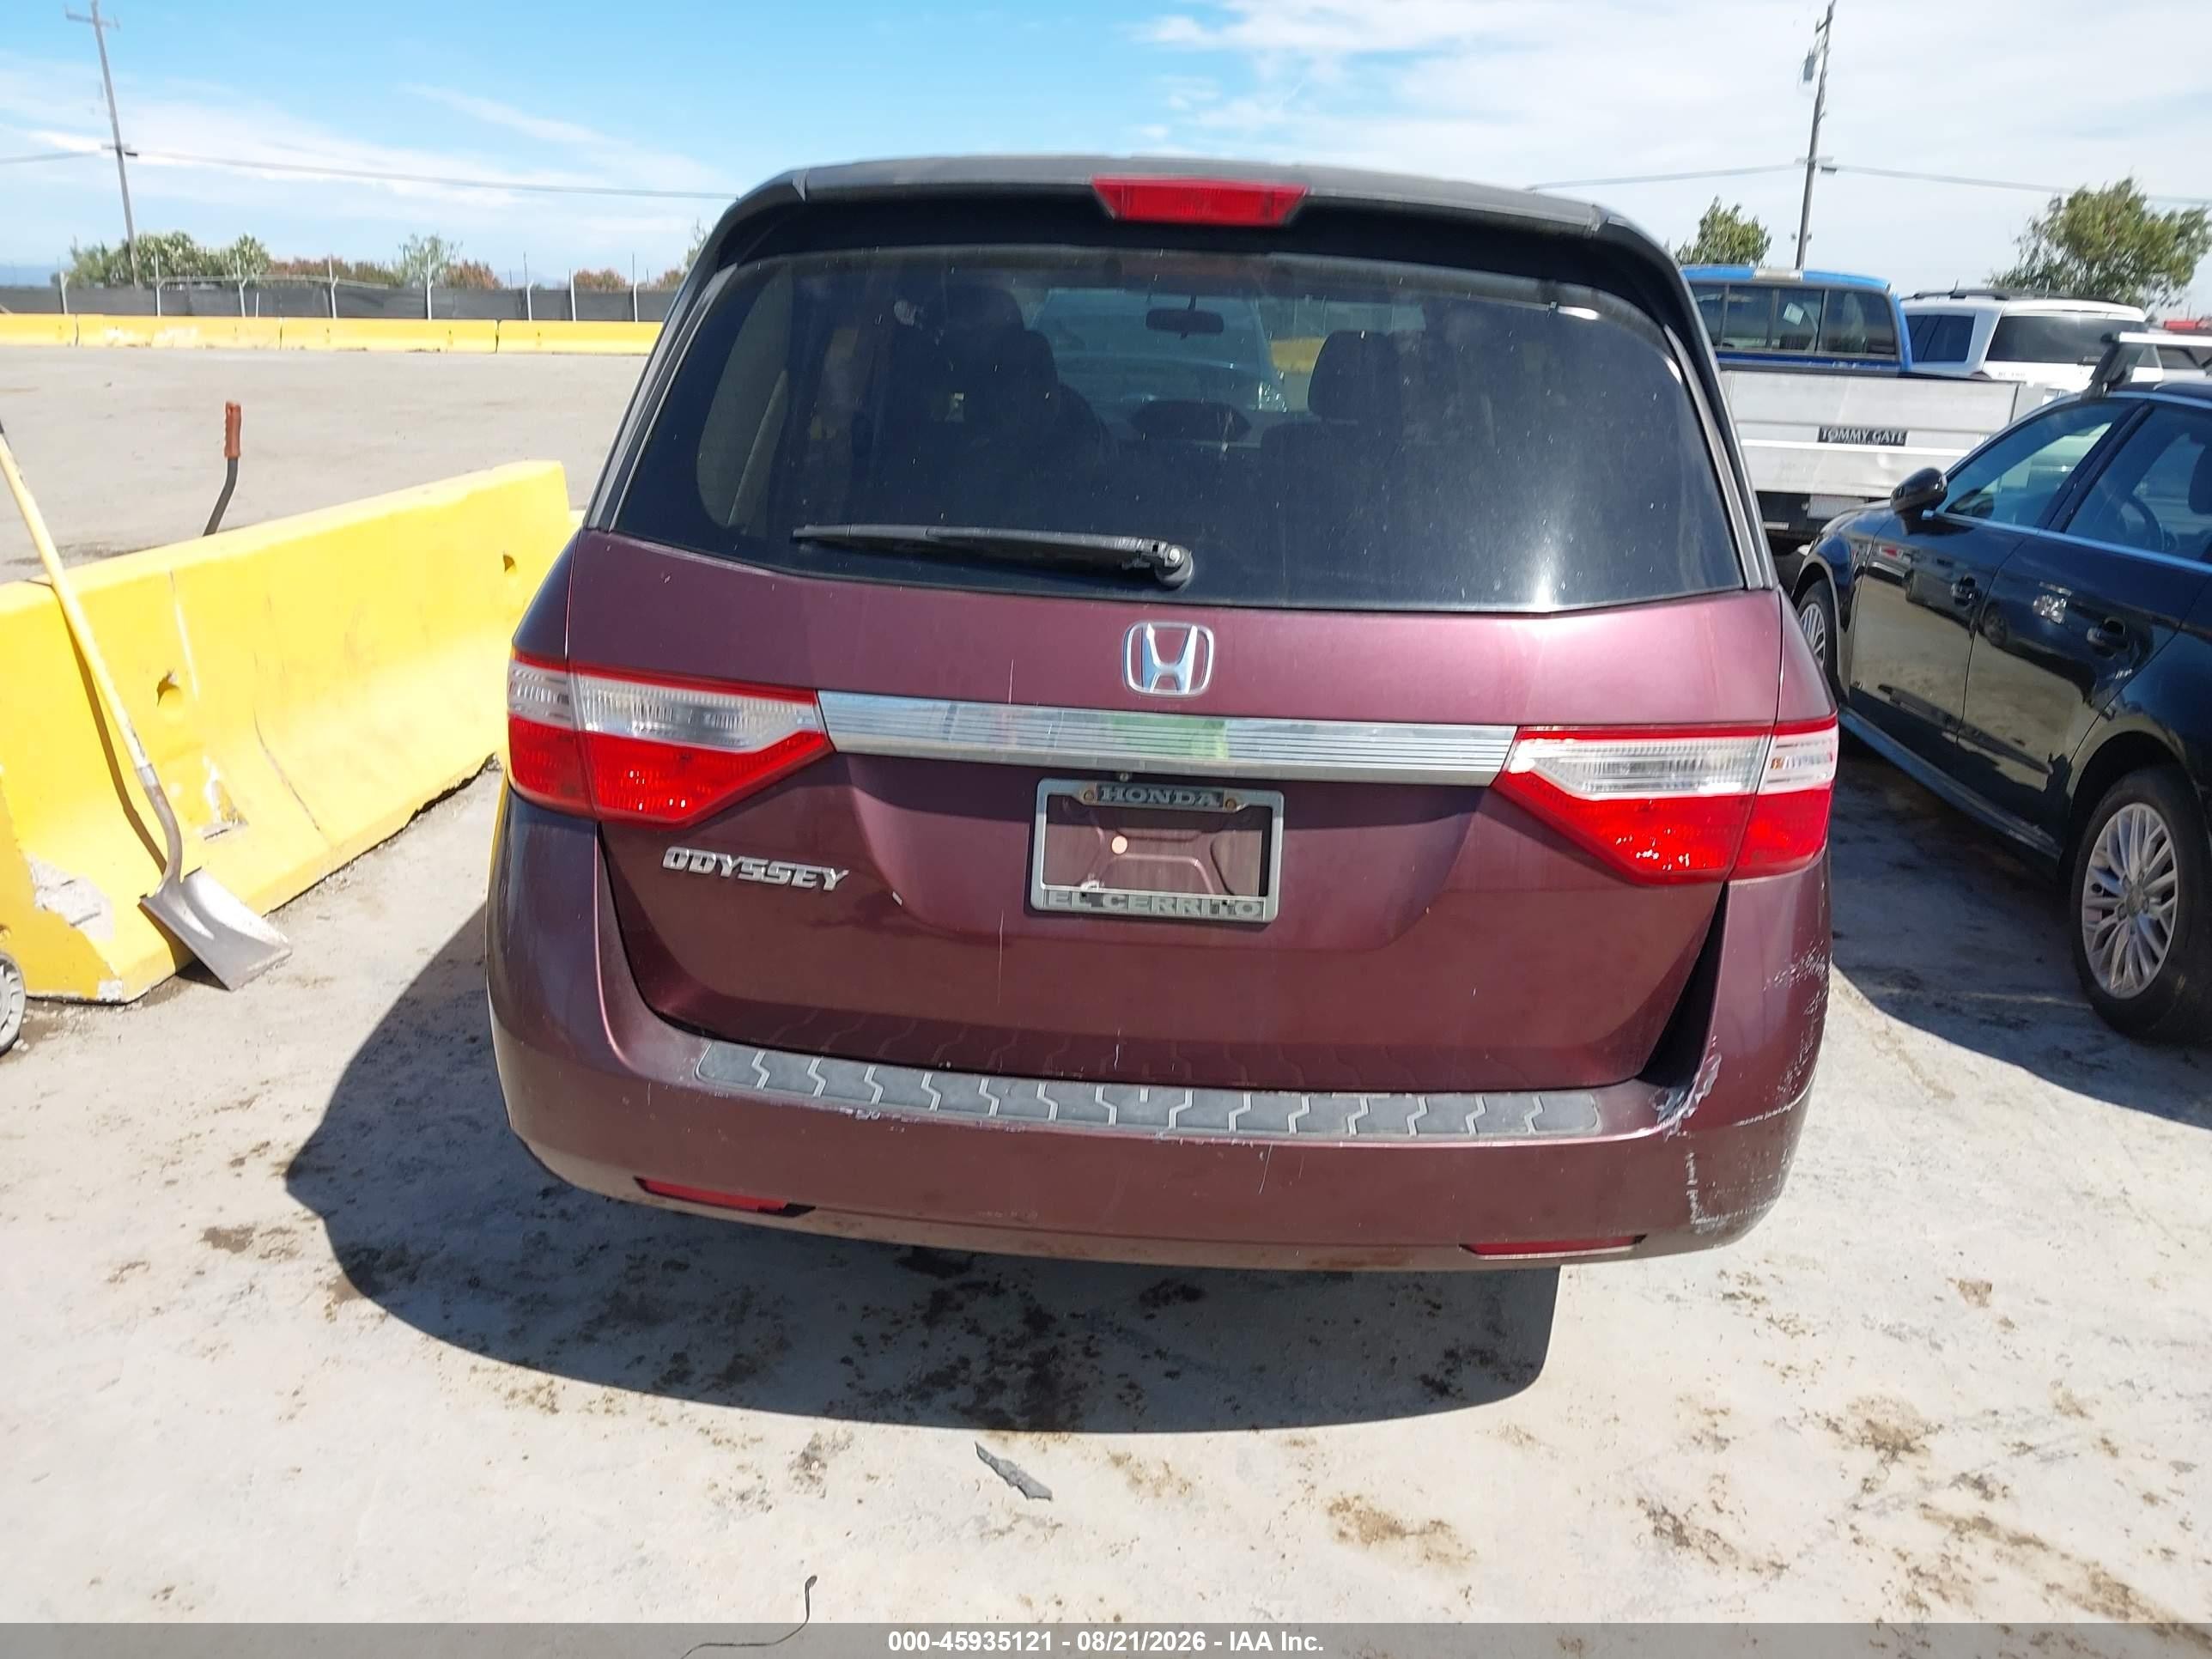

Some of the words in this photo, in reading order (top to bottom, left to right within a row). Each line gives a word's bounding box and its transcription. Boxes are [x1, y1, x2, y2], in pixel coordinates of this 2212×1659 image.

[1821, 428, 1869, 443] TOMMY
[1872, 430, 1905, 445] GATE
[1101, 786, 1220, 807] HONDA
[662, 846, 849, 891] ODYSSEY
[1049, 890, 1103, 910] EL
